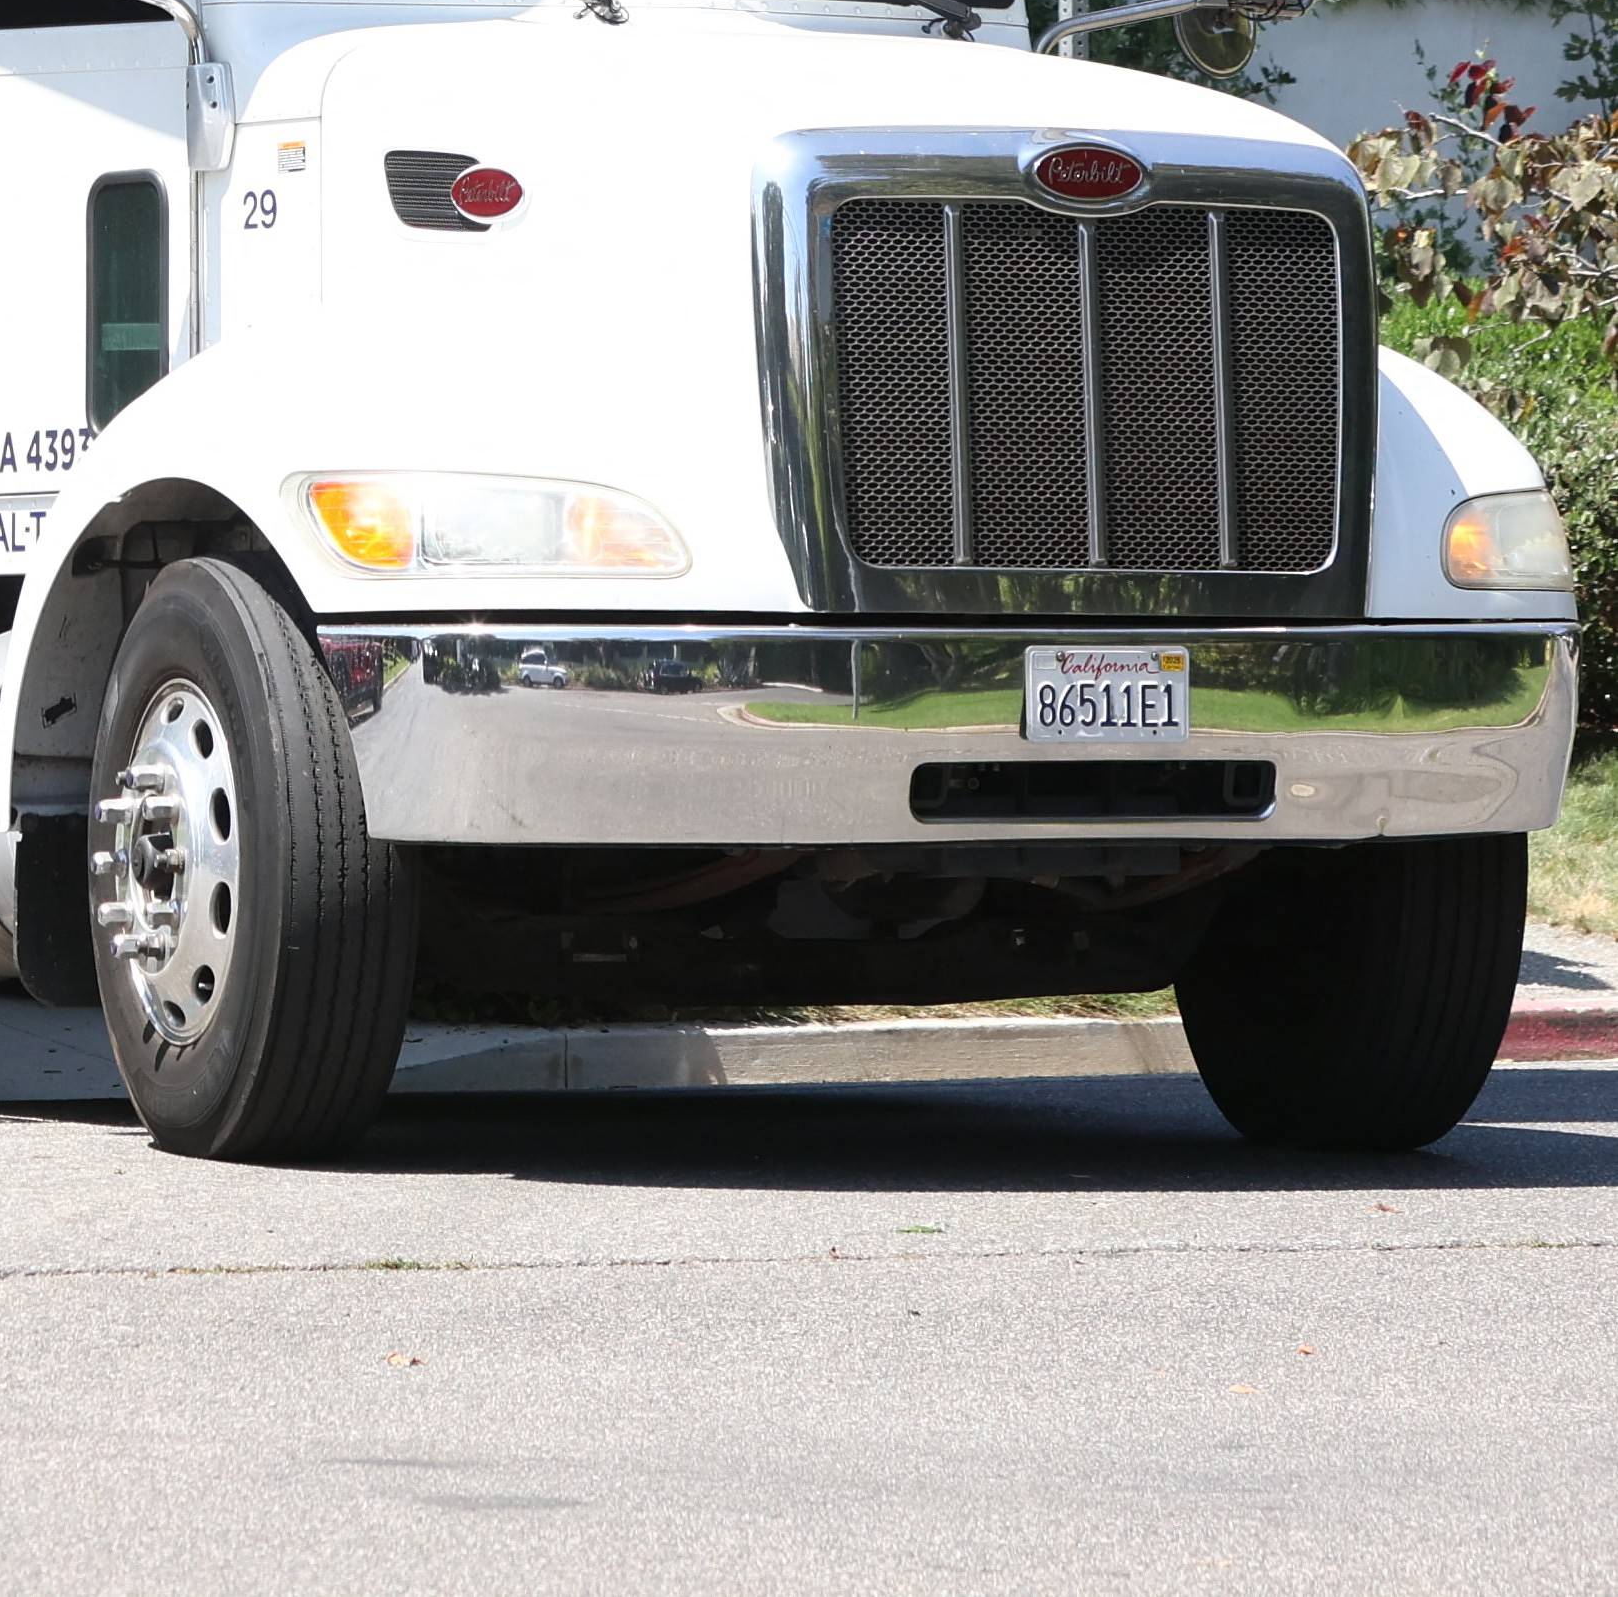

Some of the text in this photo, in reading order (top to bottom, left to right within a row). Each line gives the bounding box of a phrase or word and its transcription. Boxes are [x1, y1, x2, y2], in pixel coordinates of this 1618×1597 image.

[1048, 157, 1132, 185] Peterbilt
[243, 190, 278, 230] 29
[1060, 652, 1160, 680] California
[1038, 682, 1180, 728] 86511E1
